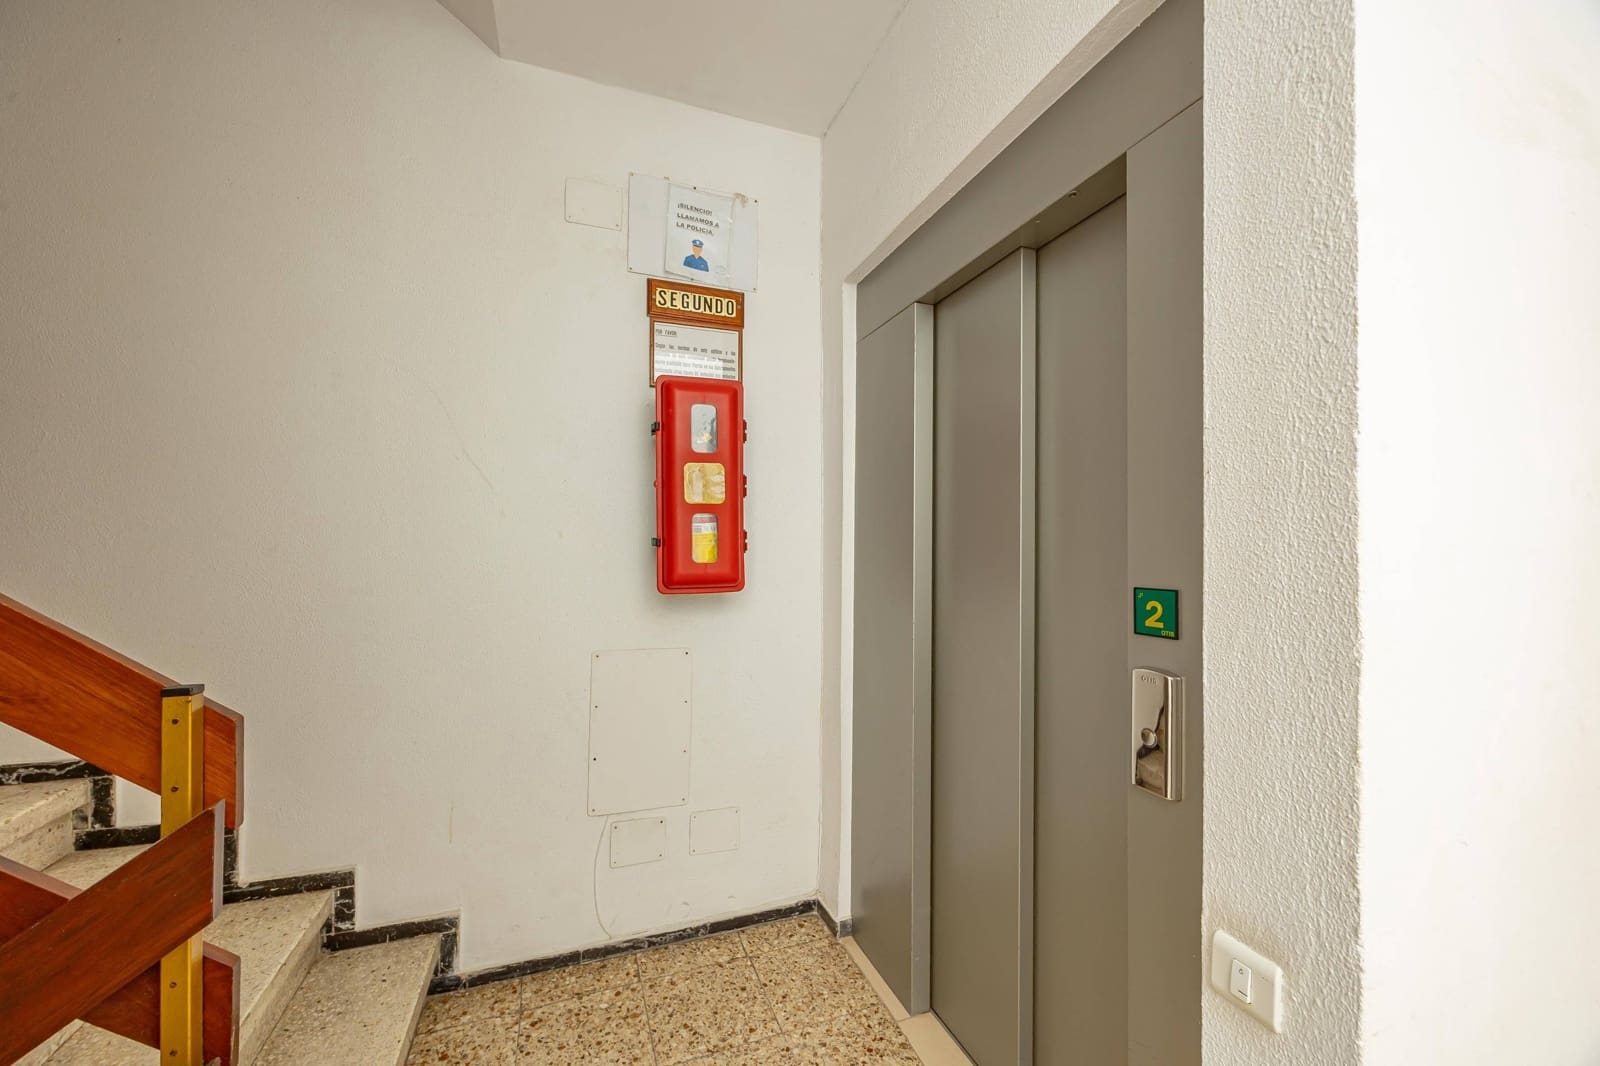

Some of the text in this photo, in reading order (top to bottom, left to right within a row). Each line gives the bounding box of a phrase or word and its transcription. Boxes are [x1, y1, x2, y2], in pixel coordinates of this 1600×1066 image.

[676, 221, 685, 229] LA
[677, 212, 720, 229] LLAMAMOS A
[657, 290, 735, 316] SEGUNDO
[1145, 600, 1164, 628] 2
[1161, 630, 1175, 638] OTIS
